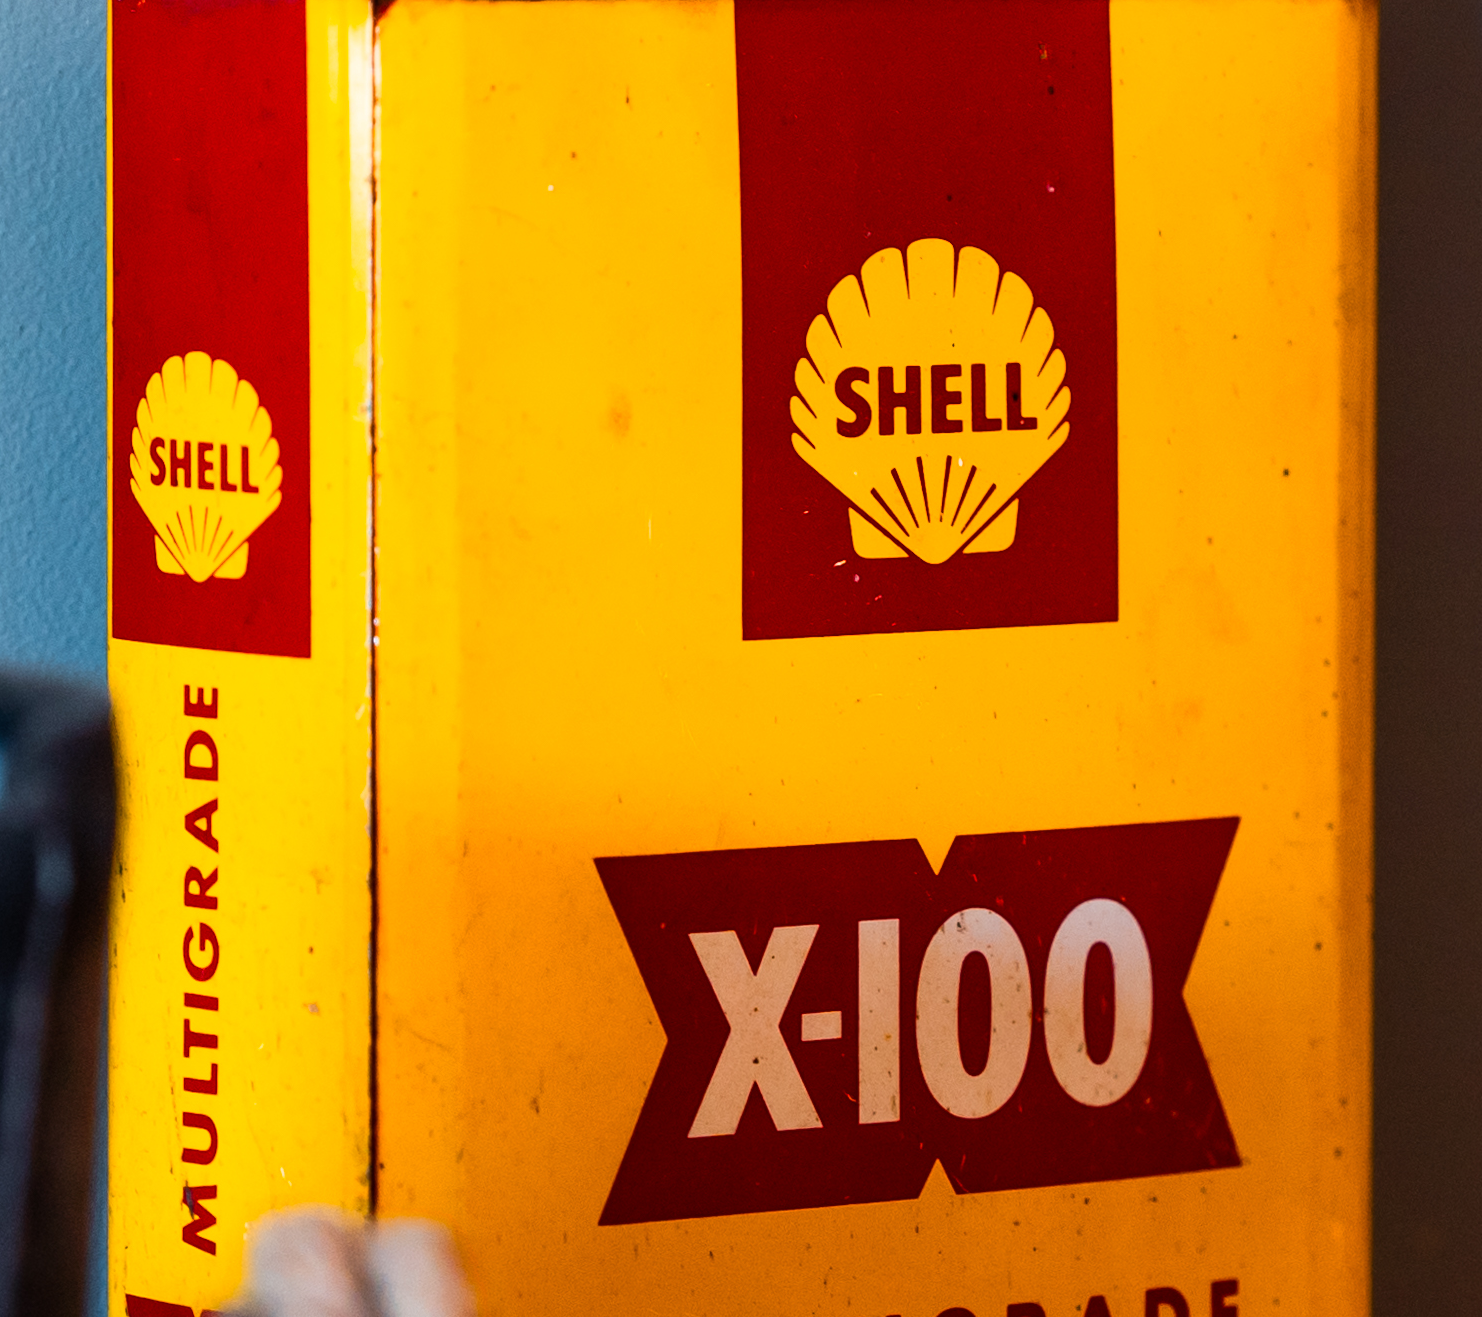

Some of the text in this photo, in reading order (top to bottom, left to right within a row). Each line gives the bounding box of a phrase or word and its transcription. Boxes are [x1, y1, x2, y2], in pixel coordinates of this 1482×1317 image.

[148, 438, 260, 497] SHELL
[834, 365, 1040, 440] SHELL
[182, 685, 220, 1256] MULTIGRADE
[687, 899, 1154, 1139] X-100
